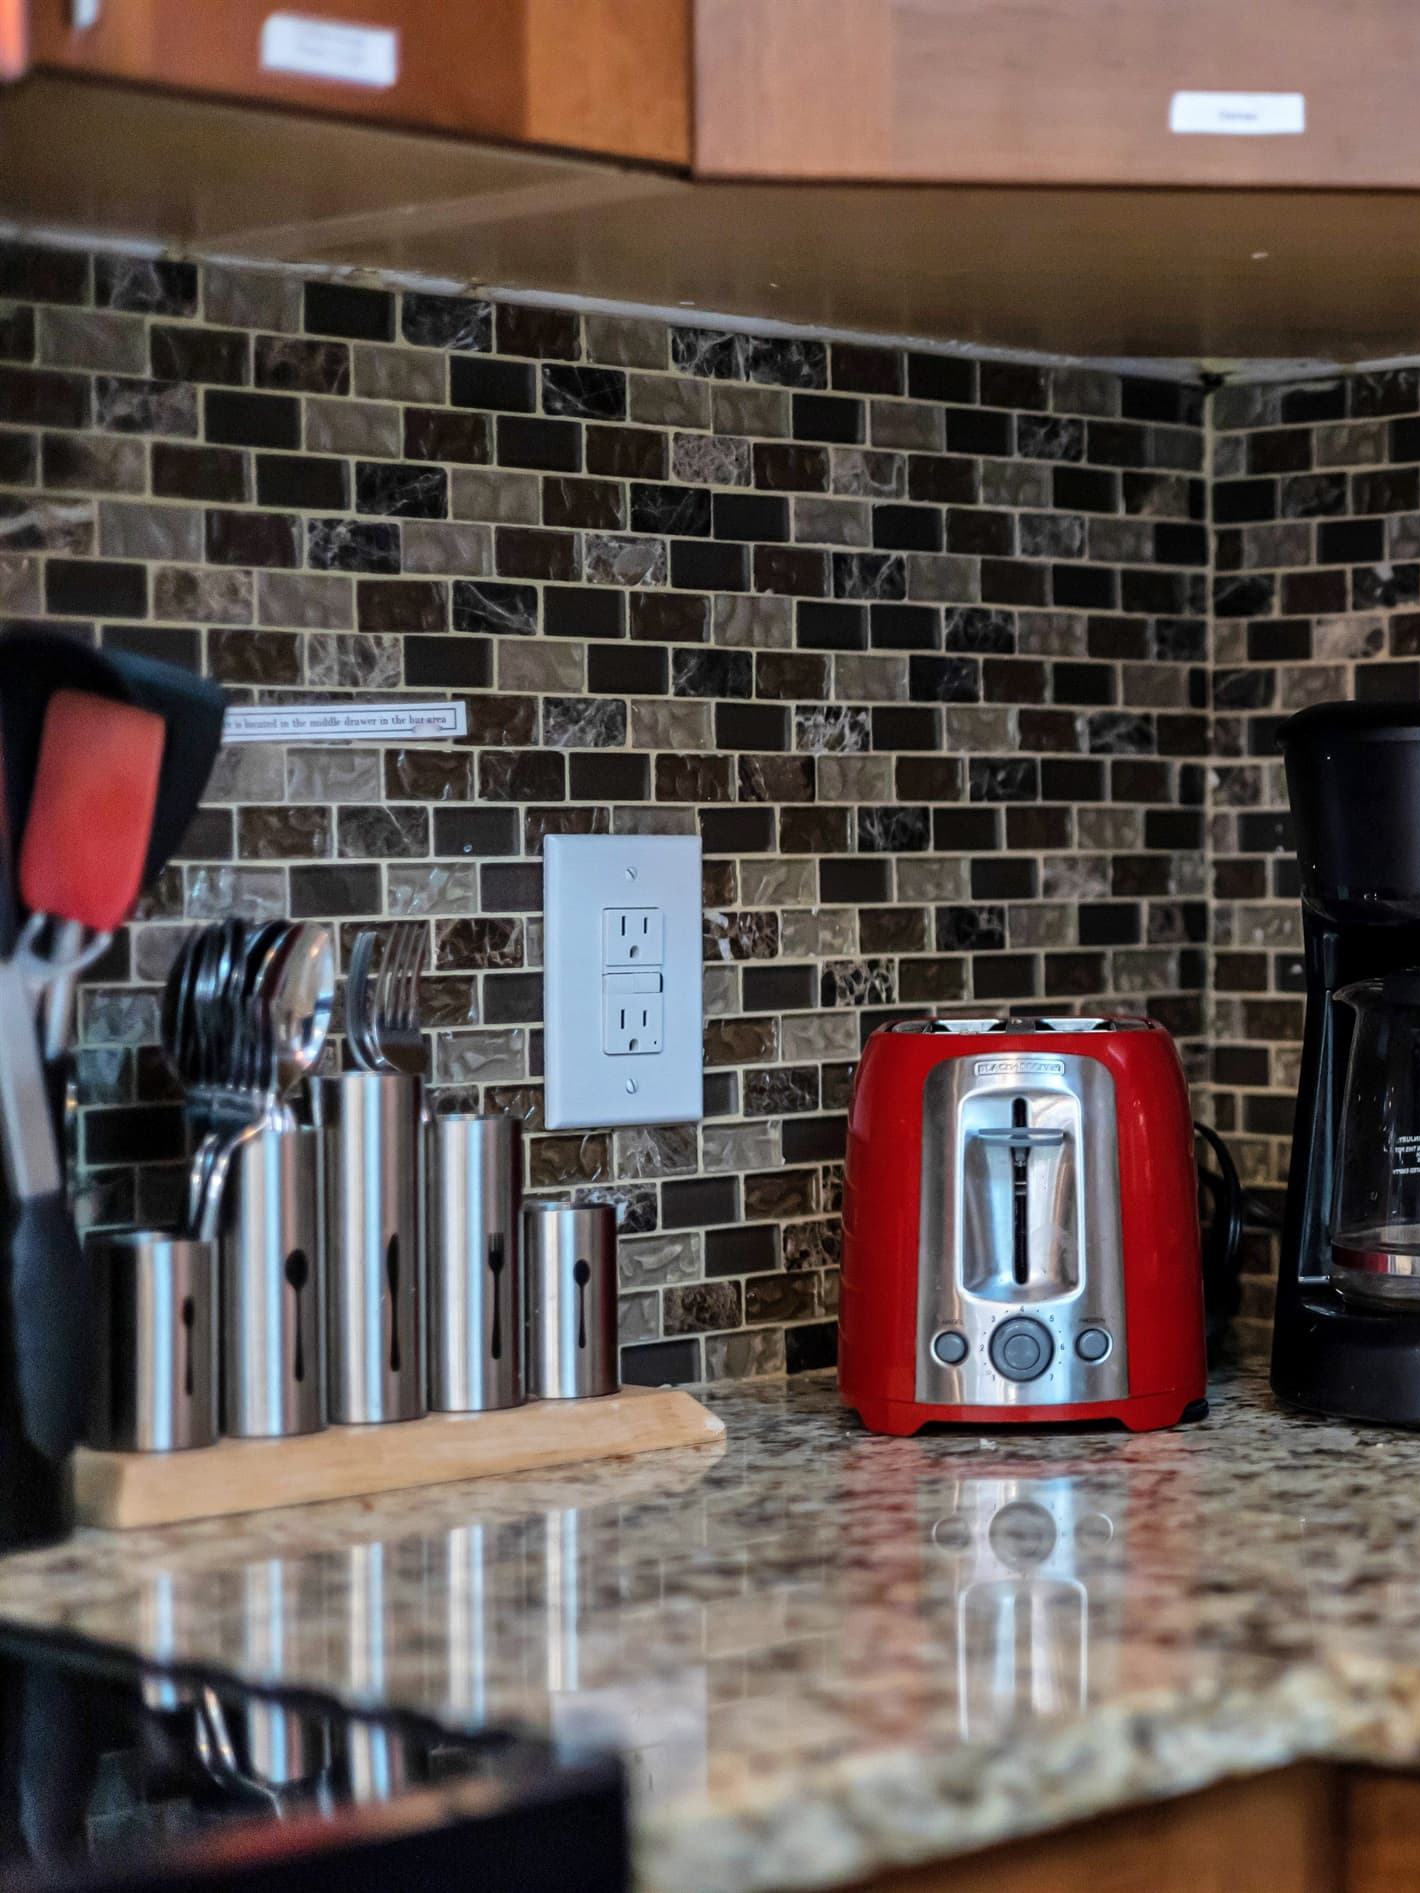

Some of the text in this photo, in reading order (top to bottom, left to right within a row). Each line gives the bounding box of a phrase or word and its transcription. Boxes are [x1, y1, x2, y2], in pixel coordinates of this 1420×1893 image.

[280, 720, 290, 729] in
[292, 717, 305, 728] the
[309, 716, 340, 728] middle
[344, 715, 376, 727] drawer
[380, 716, 389, 726] in
[392, 714, 406, 726] the
